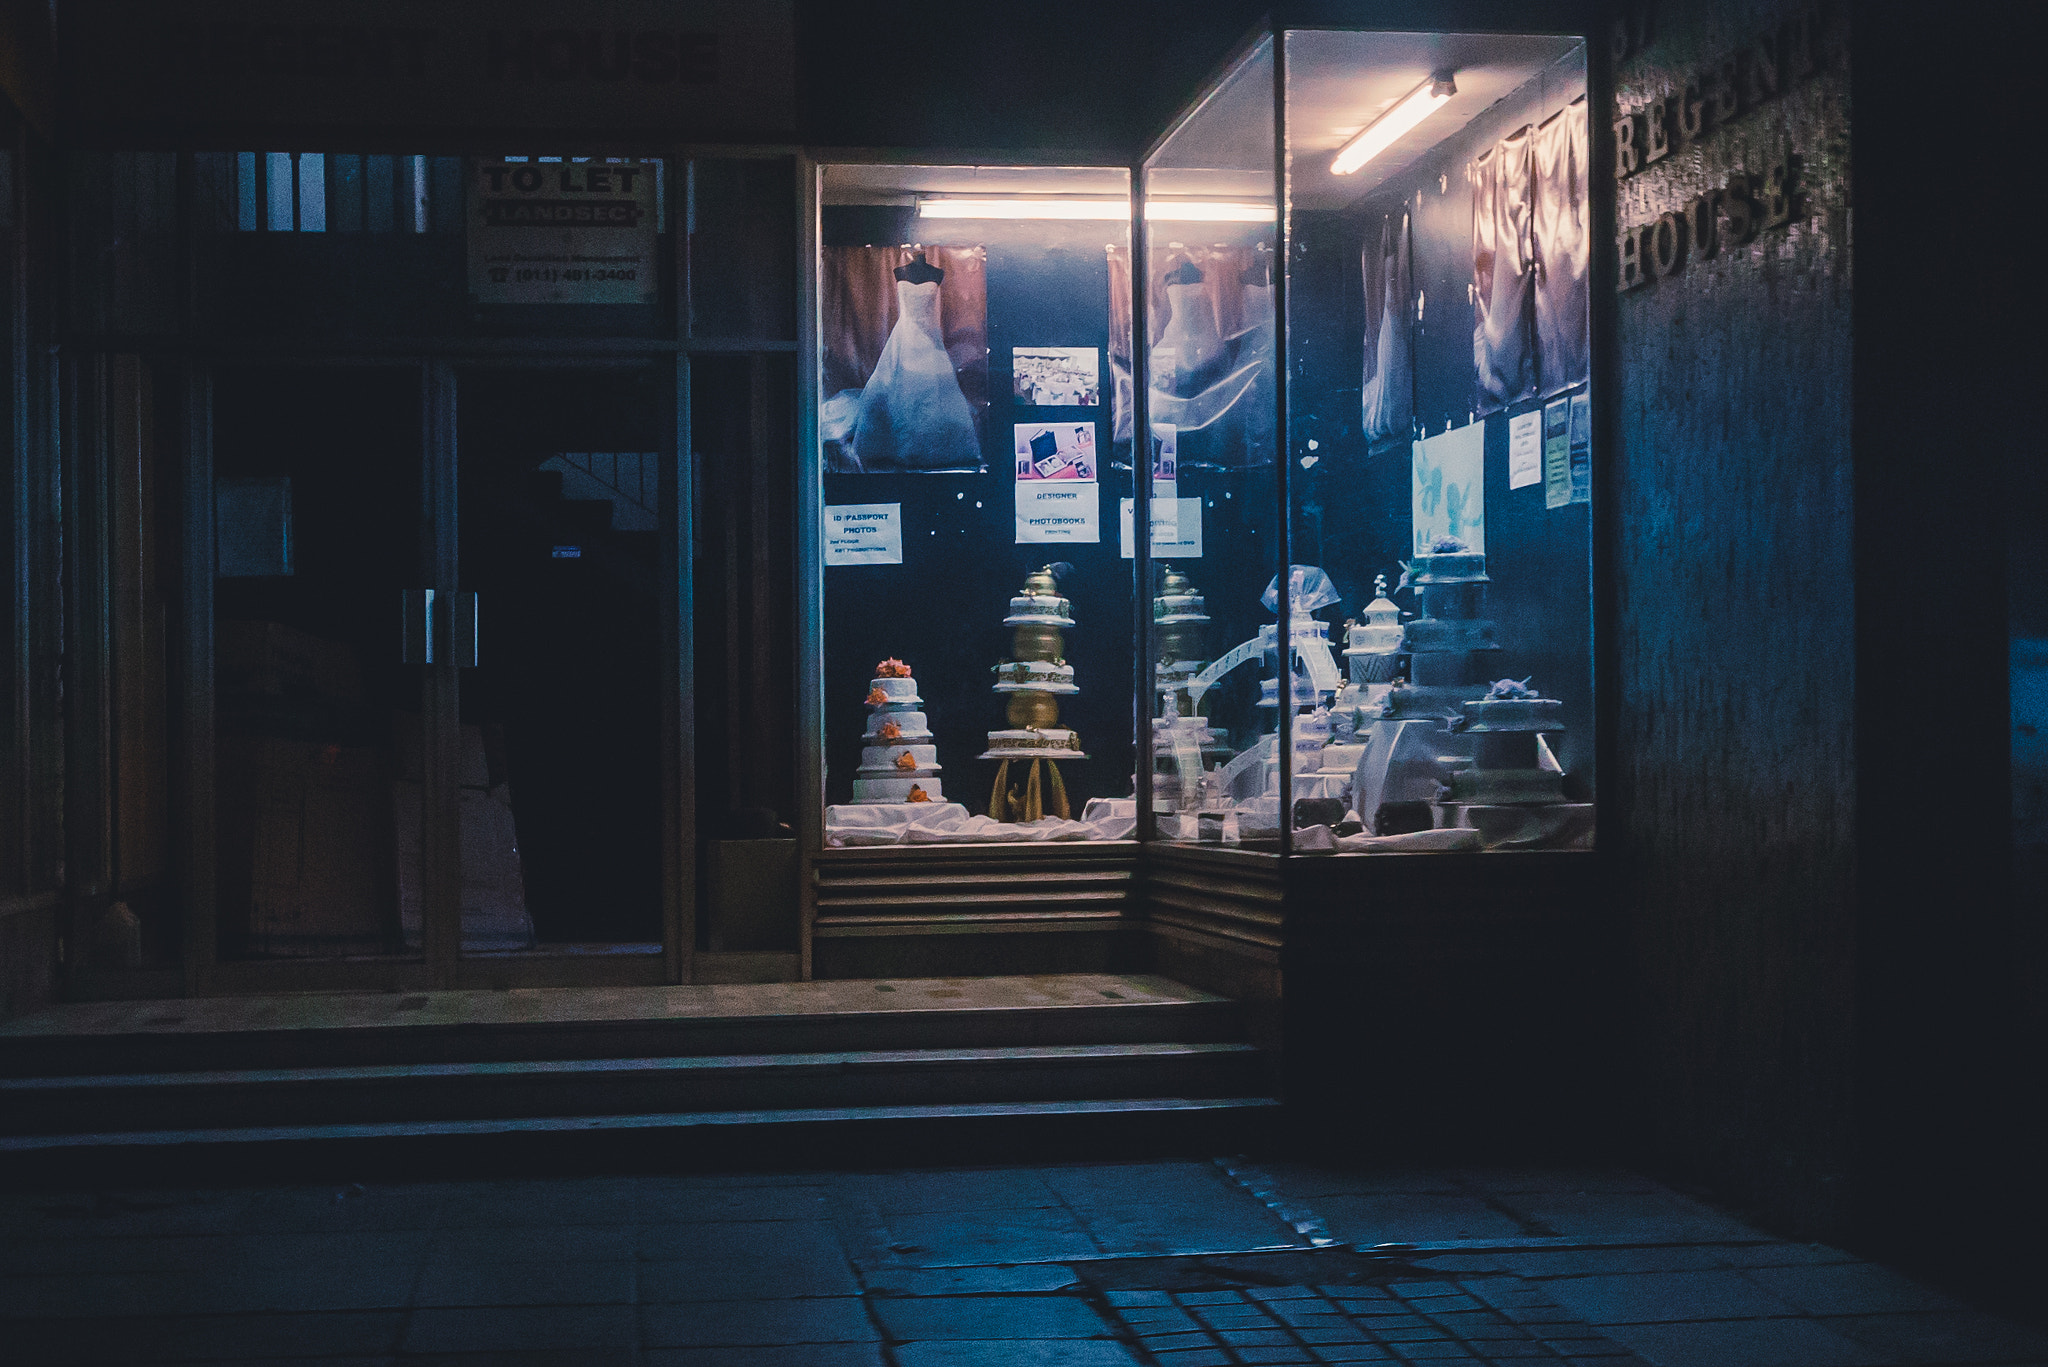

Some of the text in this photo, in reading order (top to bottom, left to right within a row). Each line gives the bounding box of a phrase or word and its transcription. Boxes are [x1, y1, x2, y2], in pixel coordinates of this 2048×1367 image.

[159, 22, 719, 84] REGENT HOUSE
[1612, 8, 1820, 180] REGENT
[482, 166, 640, 193] TO LET
[499, 205, 627, 222] LANDSEC
[1614, 150, 1790, 292] HOUSE
[516, 268, 558, 283] (011)
[843, 526, 877, 534] PHOTOS
[1029, 517, 1086, 526] PHOTOBOOKS
